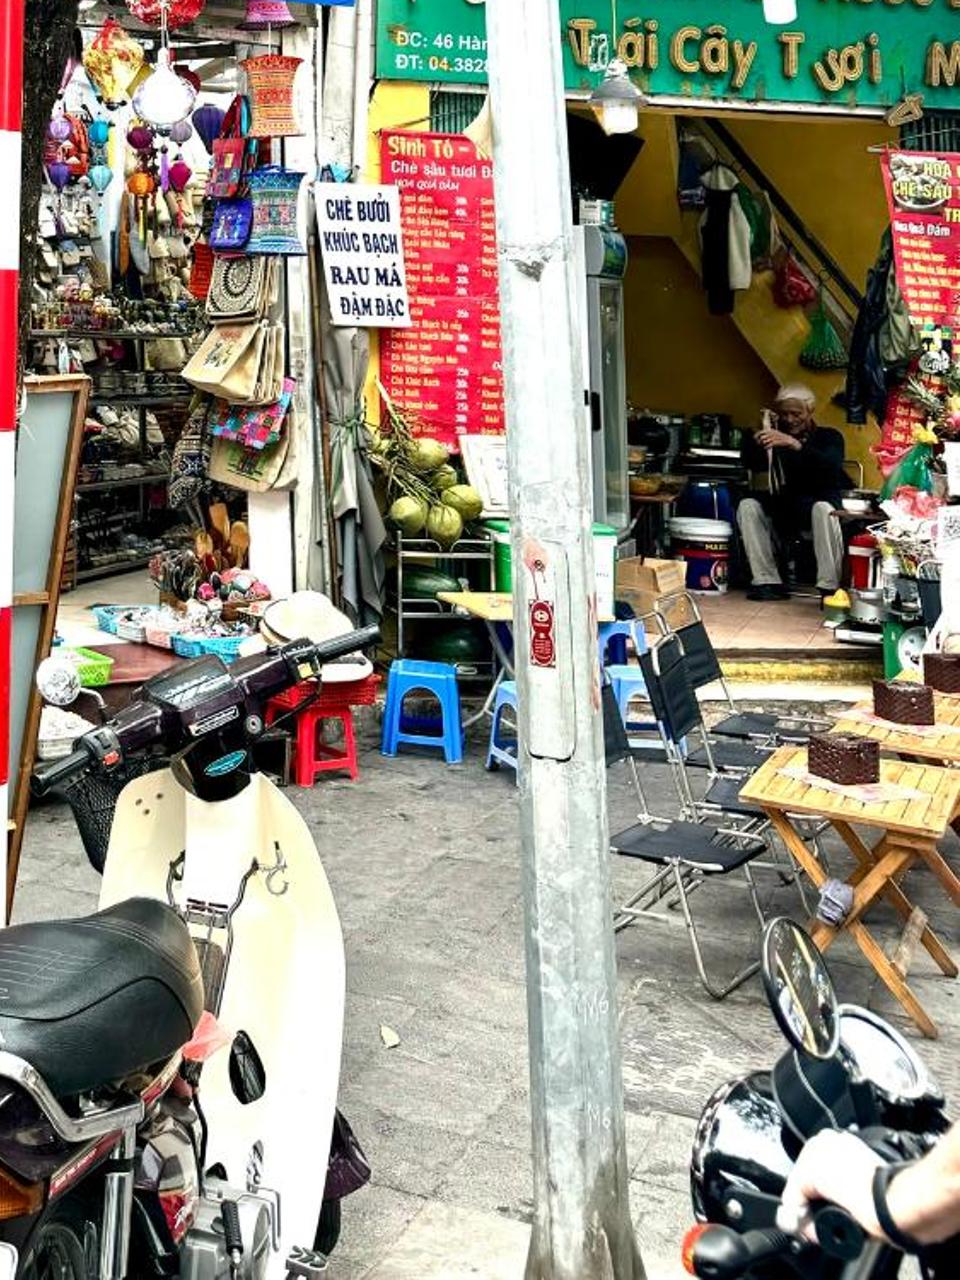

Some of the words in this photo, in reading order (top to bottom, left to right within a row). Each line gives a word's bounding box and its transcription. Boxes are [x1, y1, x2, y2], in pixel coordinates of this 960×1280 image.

[396, 30, 427, 48] ĐC:
[433, 33, 453, 49] 46
[395, 54, 423, 70] ĐT:
[670, 24, 757, 89] Cây
[387, 136, 426, 158] Sinh
[326, 195, 353, 221] CHÈ
[357, 192, 390, 222] BƯỞI
[323, 227, 360, 252] KHÚC
[362, 232, 398, 258] BẠCH
[330, 265, 370, 286] RAU
[374, 262, 402, 287] MÁ
